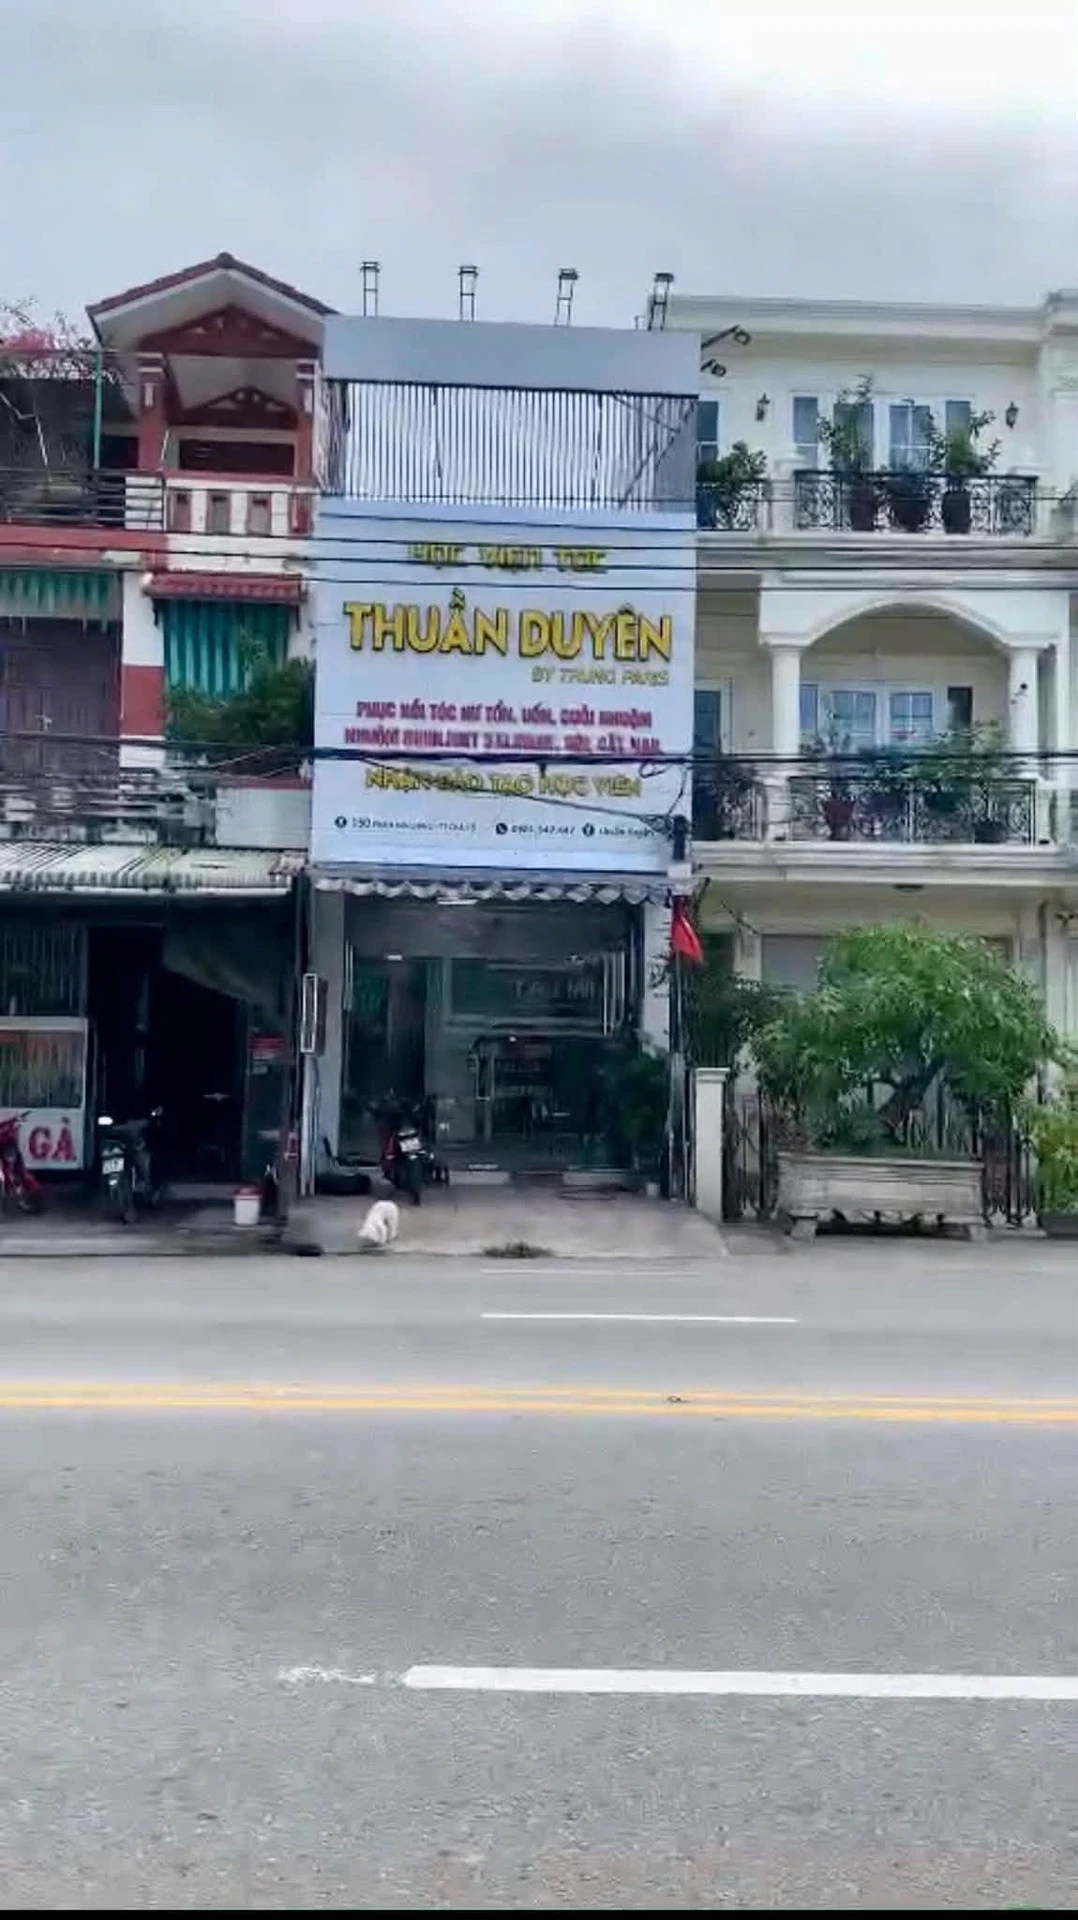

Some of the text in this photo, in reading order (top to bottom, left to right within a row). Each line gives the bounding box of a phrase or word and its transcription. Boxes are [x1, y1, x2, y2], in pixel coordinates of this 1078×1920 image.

[344, 587, 672, 662] THUẦN DUYÊN
[429, 702, 456, 721] TÓC
[28, 1117, 77, 1161] GÀ
